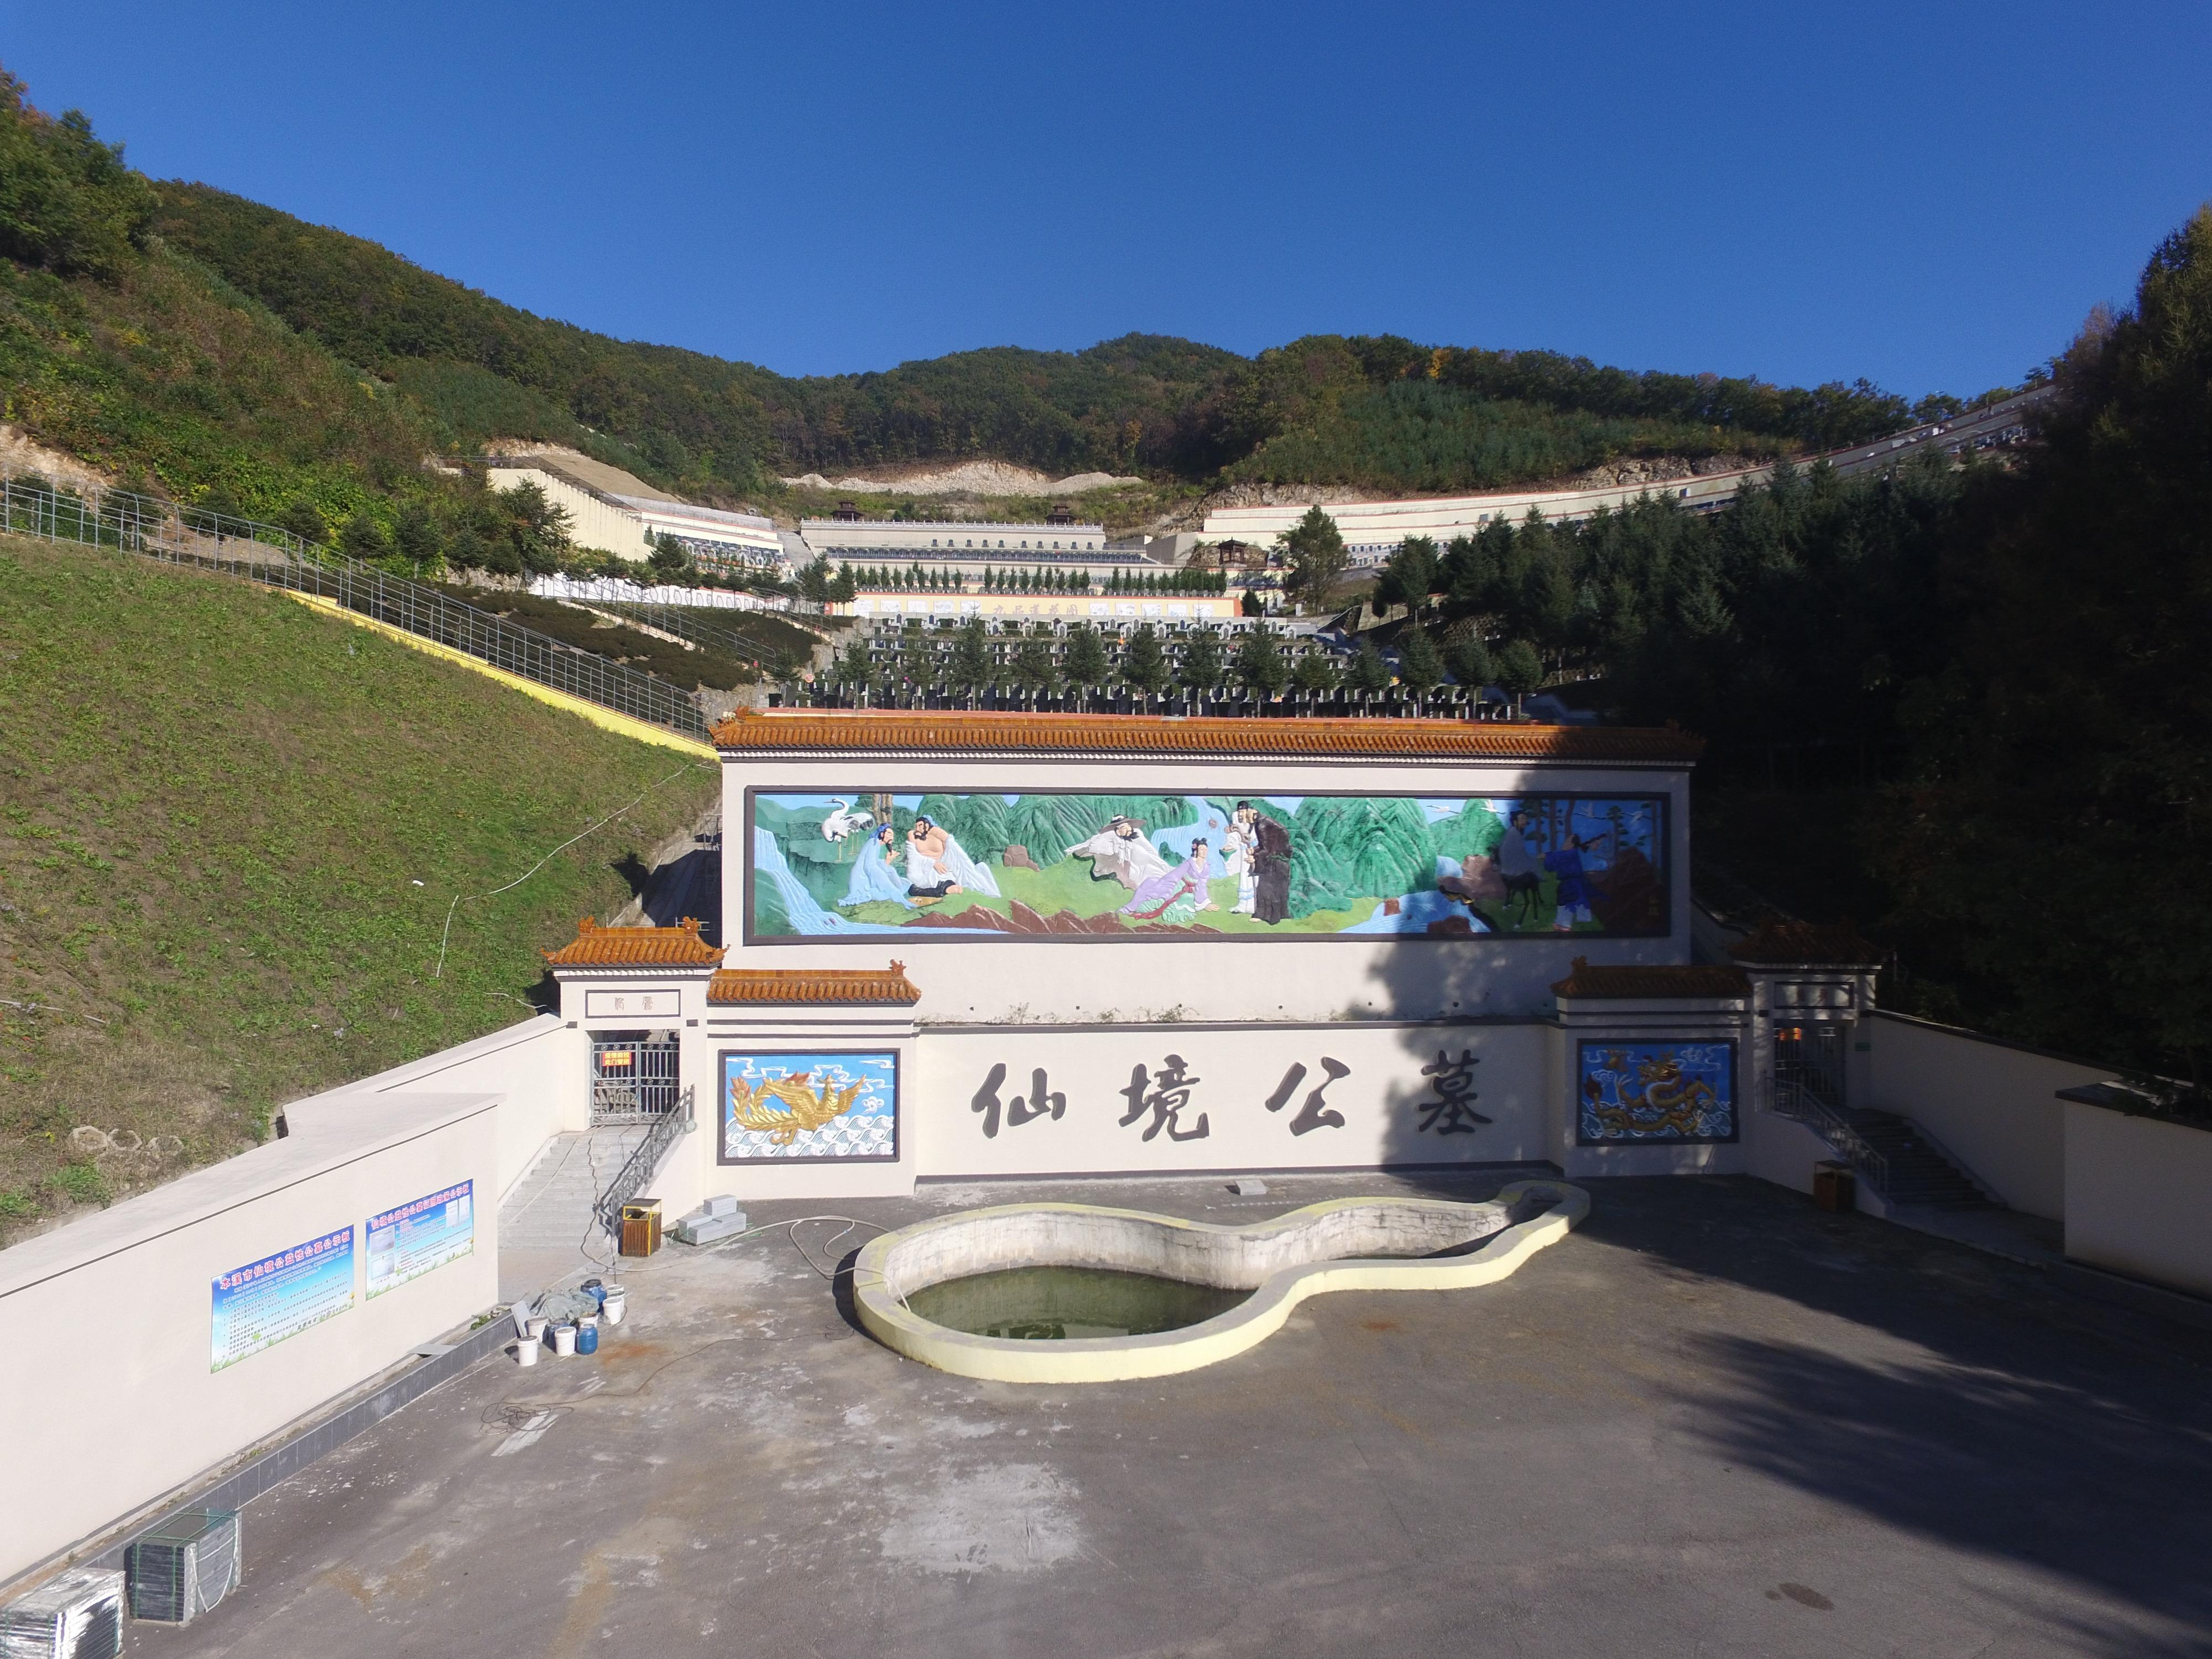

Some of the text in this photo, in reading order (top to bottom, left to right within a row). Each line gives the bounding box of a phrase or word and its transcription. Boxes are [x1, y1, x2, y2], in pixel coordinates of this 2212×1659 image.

[971, 1050, 1492, 1141] 仙境公墓
[220, 1230, 351, 1290] 本溪市仙境公益性公墓公示板
